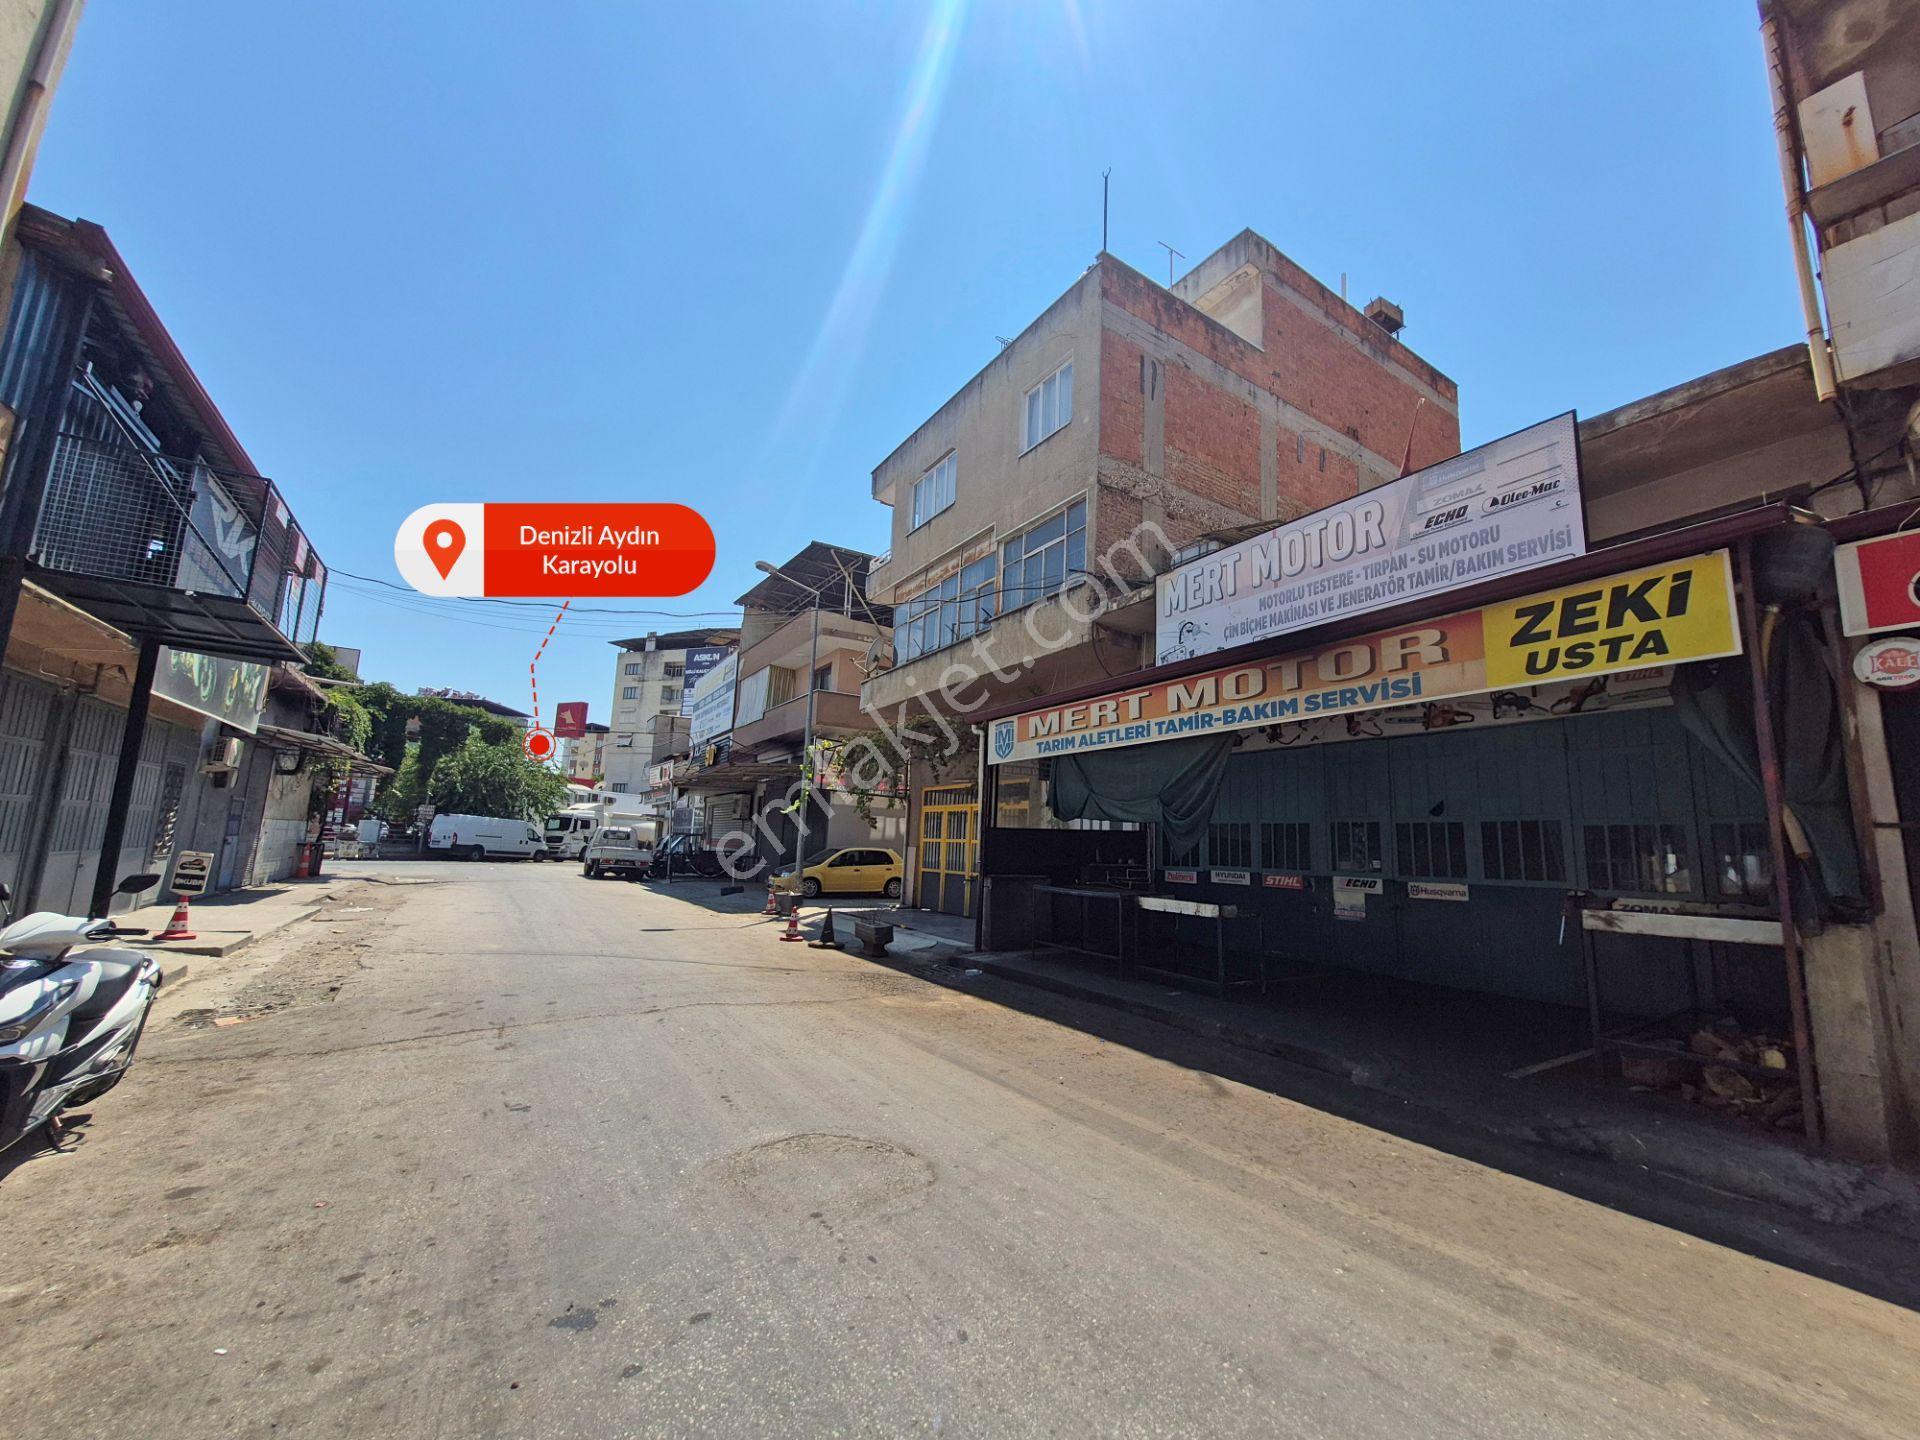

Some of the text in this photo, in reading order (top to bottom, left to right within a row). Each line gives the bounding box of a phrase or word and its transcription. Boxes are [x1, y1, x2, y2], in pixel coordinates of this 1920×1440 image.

[1424, 505, 1469, 530] ECHO
[1163, 500, 1386, 617] MERT MOTOR
[1224, 524, 1572, 642] ÇİM BİÇME MAKİNASI VE JENERATÖR TAMİR/BAKIM SERVİSİ
[1259, 586, 1305, 611] MOTORLU
[1307, 570, 1354, 598] TESTERE
[1363, 552, 1408, 581] TIRPAN
[1418, 545, 1435, 565] SU
[1439, 524, 1500, 559] MOTORU
[1509, 569, 1693, 648] ZEKİ
[1028, 628, 1448, 740] MERT MOTOR
[1525, 629, 1669, 676] USTA
[1036, 672, 1422, 754] TARIM ALETLERİ TAMİR-BAKIM SERVİSİ
[1215, 871, 1246, 880] HYUNDAI
[1265, 875, 1301, 887] STIHL
[1345, 878, 1377, 889] ECHO
[1420, 887, 1466, 898] Husqvarna
